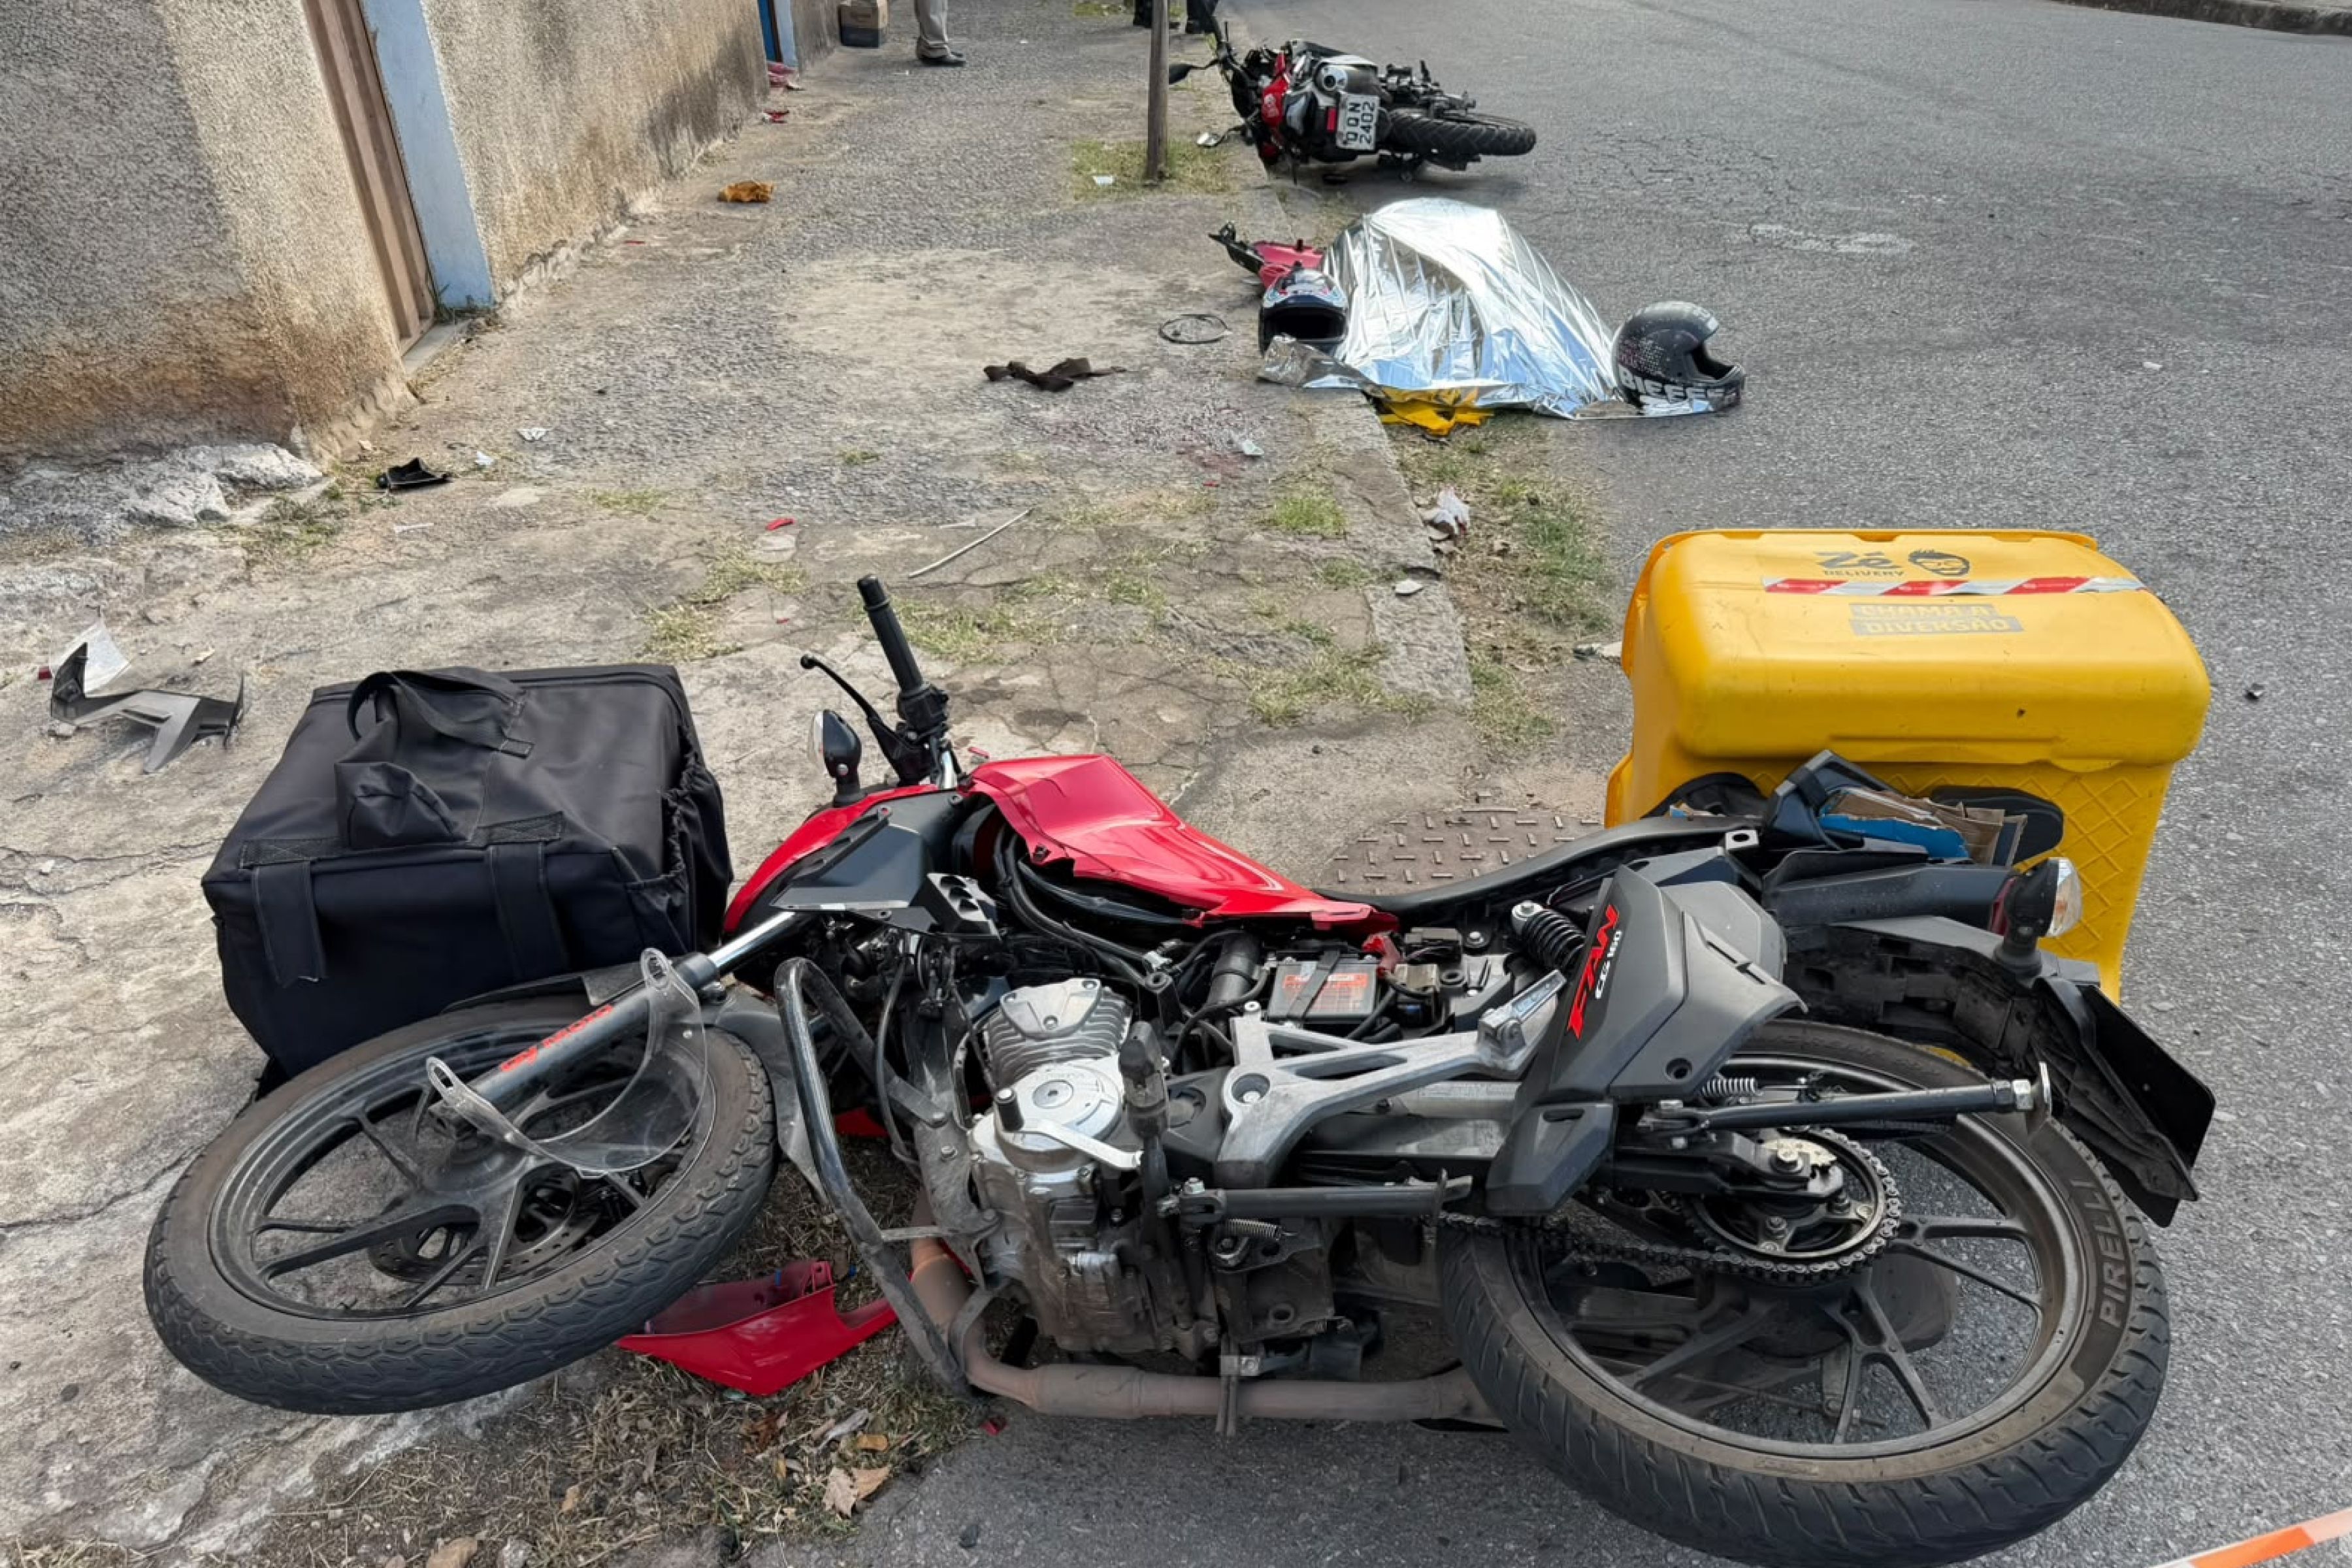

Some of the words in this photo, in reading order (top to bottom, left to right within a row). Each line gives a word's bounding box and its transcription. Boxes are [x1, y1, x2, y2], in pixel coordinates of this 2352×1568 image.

[1360, 101, 1375, 144] 2402
[1813, 551, 1903, 568] Zé
[1859, 605, 1963, 617] CHAMA
[1970, 605, 1991, 617] A
[1866, 617, 2011, 632] DIVERSÃO
[1567, 904, 1619, 1040] FAN
[2070, 1178, 2127, 1329] PIRELLI
